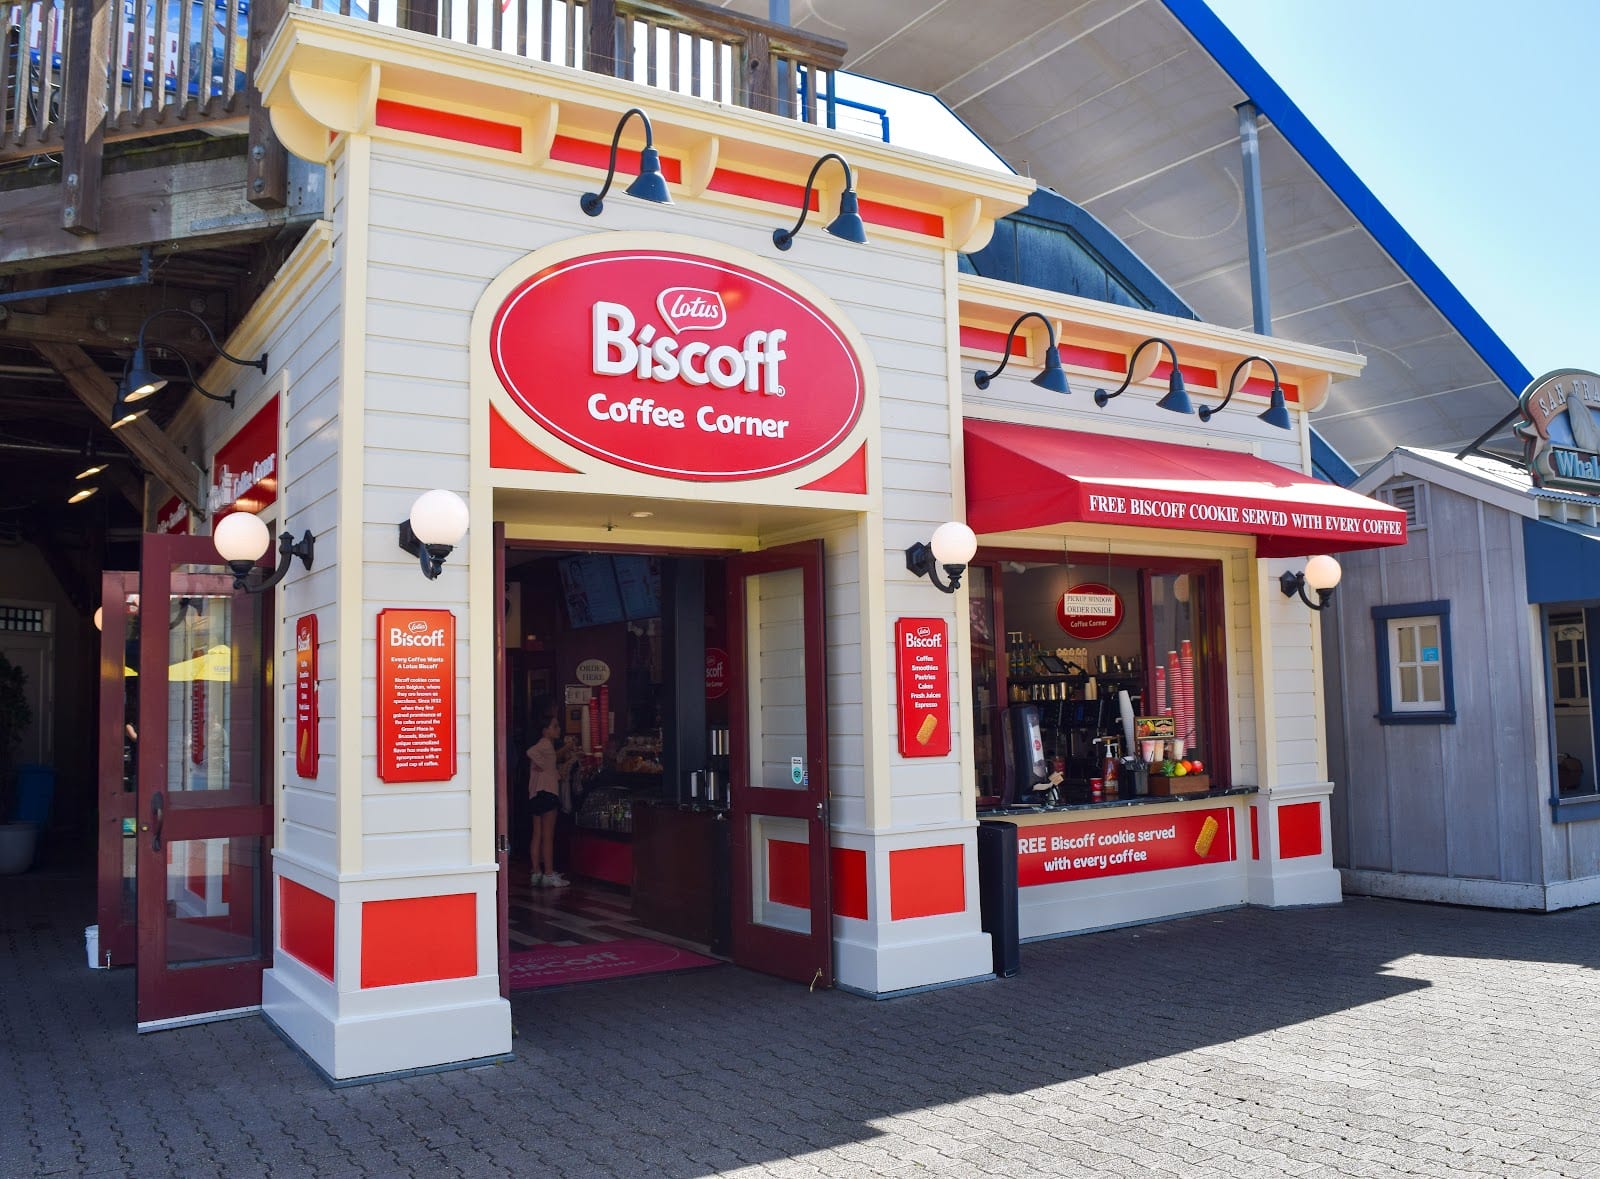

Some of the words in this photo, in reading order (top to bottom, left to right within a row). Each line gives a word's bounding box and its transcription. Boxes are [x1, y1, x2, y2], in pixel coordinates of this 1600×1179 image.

[671, 294, 719, 319] Lotus
[593, 301, 787, 394] Biscoff
[1539, 384, 1566, 416] SAN
[588, 393, 685, 428] Coffee
[696, 406, 790, 438] Corner
[1554, 450, 1600, 480] Whal
[1089, 495, 1126, 514] FREE
[1130, 499, 1186, 519] BISCOFF
[1190, 504, 1239, 523] COOKIE
[1242, 509, 1288, 527] SERVED
[1291, 513, 1322, 530] WITH
[1325, 516, 1361, 533] EVERY
[1362, 519, 1402, 536] COFFEE
[1067, 606, 1090, 614] ORDER
[1090, 606, 1113, 614] INSIDE
[391, 628, 445, 647] Biscoff
[906, 633, 942, 647] Biscoff
[580, 664, 606, 672] ORDER
[1018, 837, 1047, 854] REE
[1051, 833, 1096, 851] Biscoff
[1098, 830, 1135, 846] cookie
[1138, 825, 1175, 841] served
[1044, 855, 1071, 871] with
[1073, 853, 1107, 869] every
[1109, 850, 1147, 863] coffee
